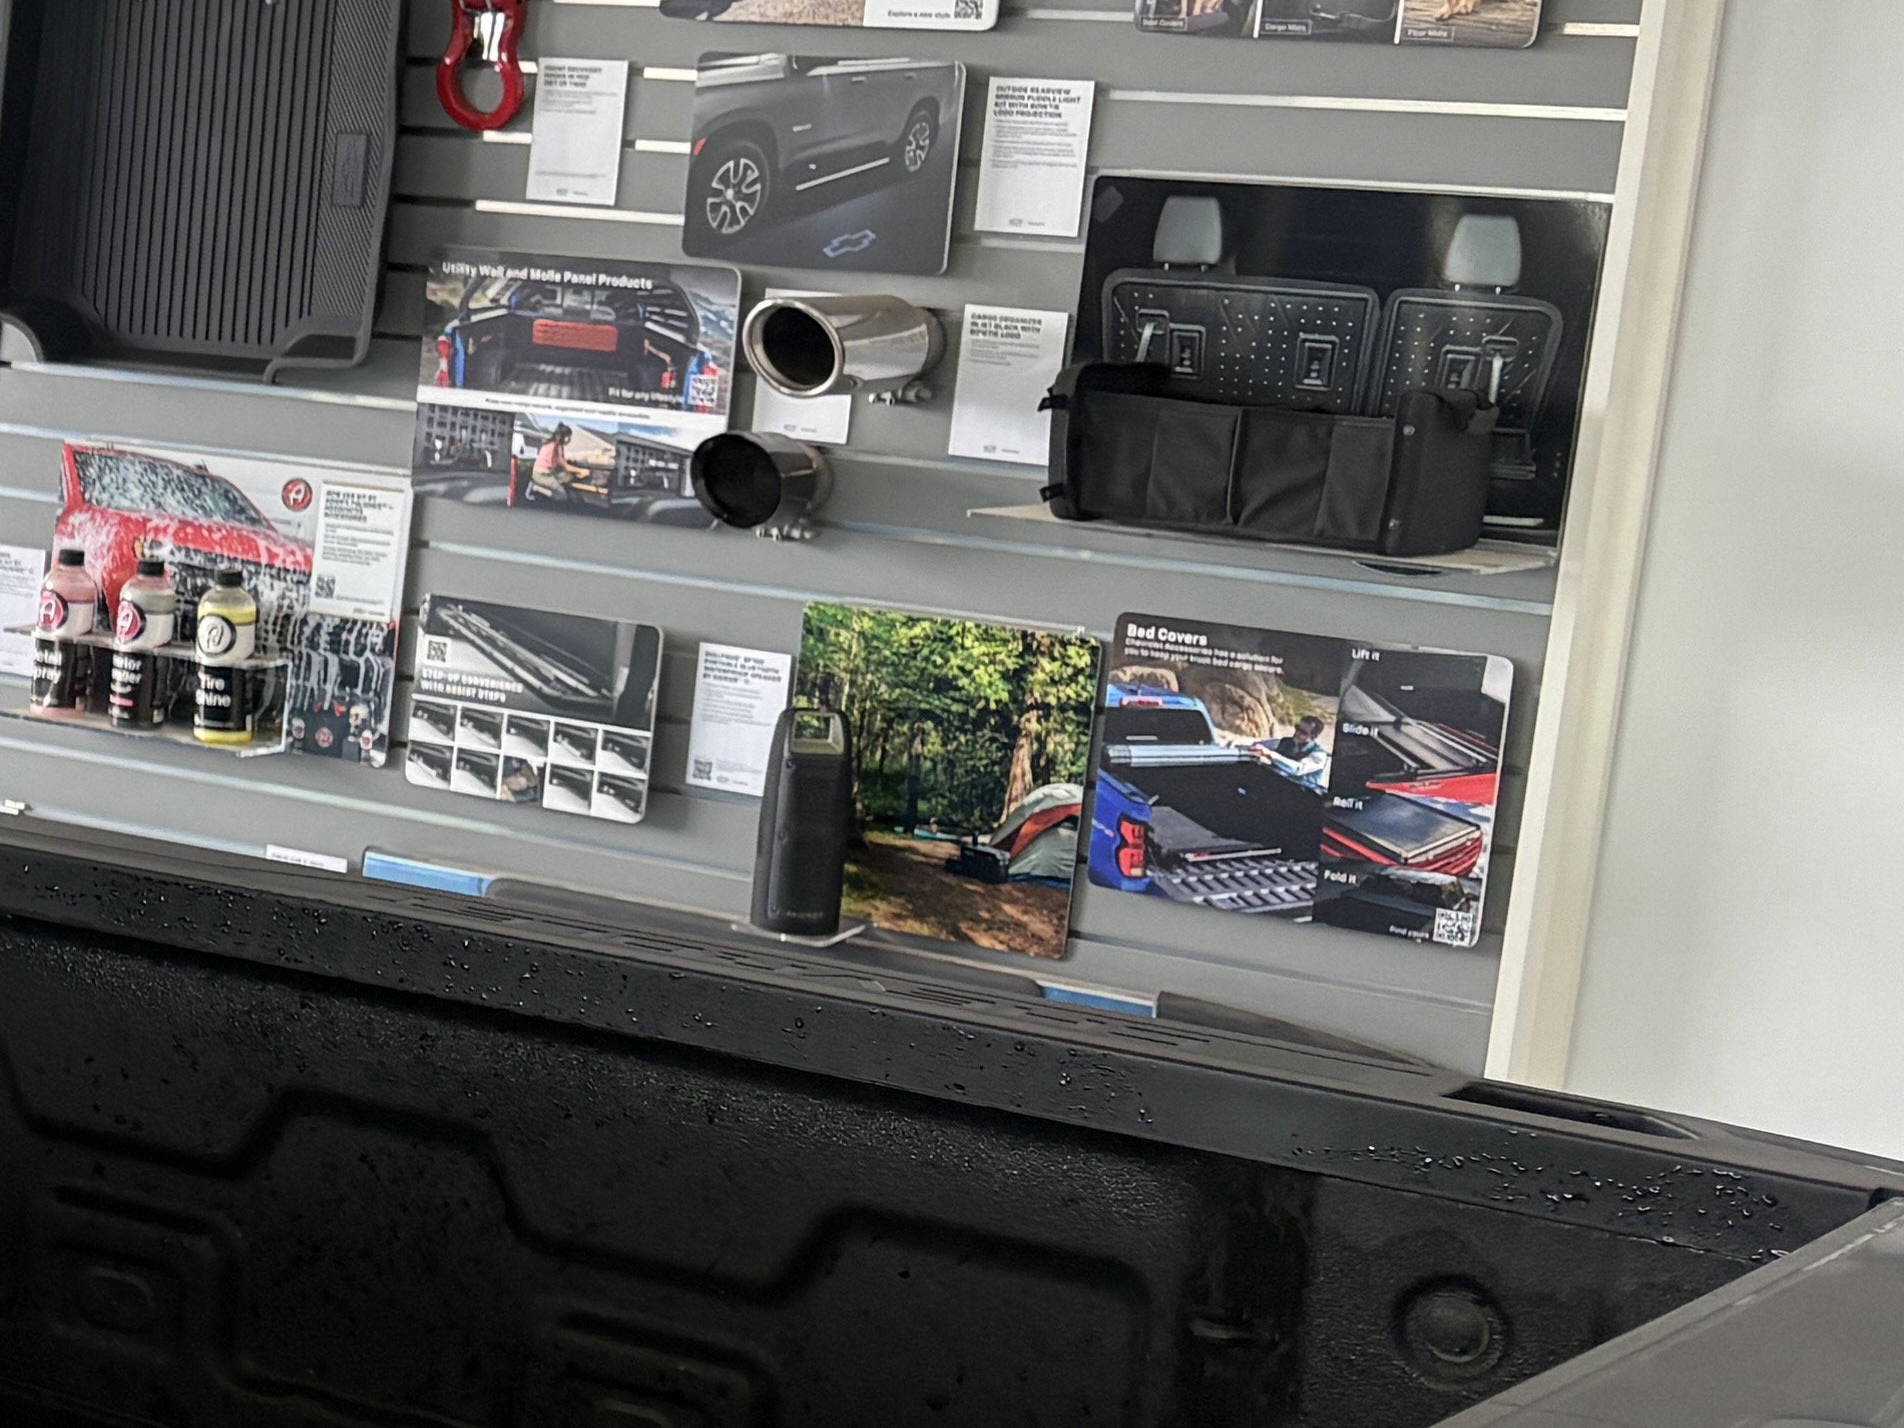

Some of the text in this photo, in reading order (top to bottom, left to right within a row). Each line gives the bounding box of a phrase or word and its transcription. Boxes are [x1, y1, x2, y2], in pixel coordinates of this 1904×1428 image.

[1264, 22, 1287, 32] Cargo
[996, 85, 1072, 95] OUTSIDE REARVIEW
[1008, 101, 1029, 110] WITH
[1058, 96, 1082, 105] LIGHT
[993, 109, 1062, 119] LOGO PROJECTION
[442, 261, 653, 291] Utility Wall and Molle Panel Products
[971, 312, 1043, 326] CARGO ORGANIZER
[993, 323, 1019, 332] BLACK
[608, 386, 620, 398] Fit
[621, 388, 634, 399] for
[634, 392, 649, 402] any
[1126, 623, 1208, 647] Bed Covers
[1124, 647, 1139, 657] you
[1140, 648, 1150, 657] to
[1150, 649, 1170, 661] keep
[1170, 653, 1189, 663] your
[1212, 657, 1229, 668] bed
[1229, 660, 1253, 672] cargo
[1164, 642, 1213, 656] Accessories
[1214, 648, 1229, 658] has
[1230, 651, 1236, 659] a
[1236, 651, 1270, 663] solution
[1270, 655, 1284, 664] for
[1351, 648, 1380, 662] Lift it
[197, 671, 225, 691] Tire
[422, 667, 523, 693] STEP-UP CONVENIENCE
[420, 679, 444, 692] WITH
[445, 681, 477, 698] ASSIST
[195, 688, 231, 707] Shine
[1342, 723, 1379, 737] Slide it
[1332, 796, 1364, 811] Roll it
[1324, 870, 1357, 885] Fold it
